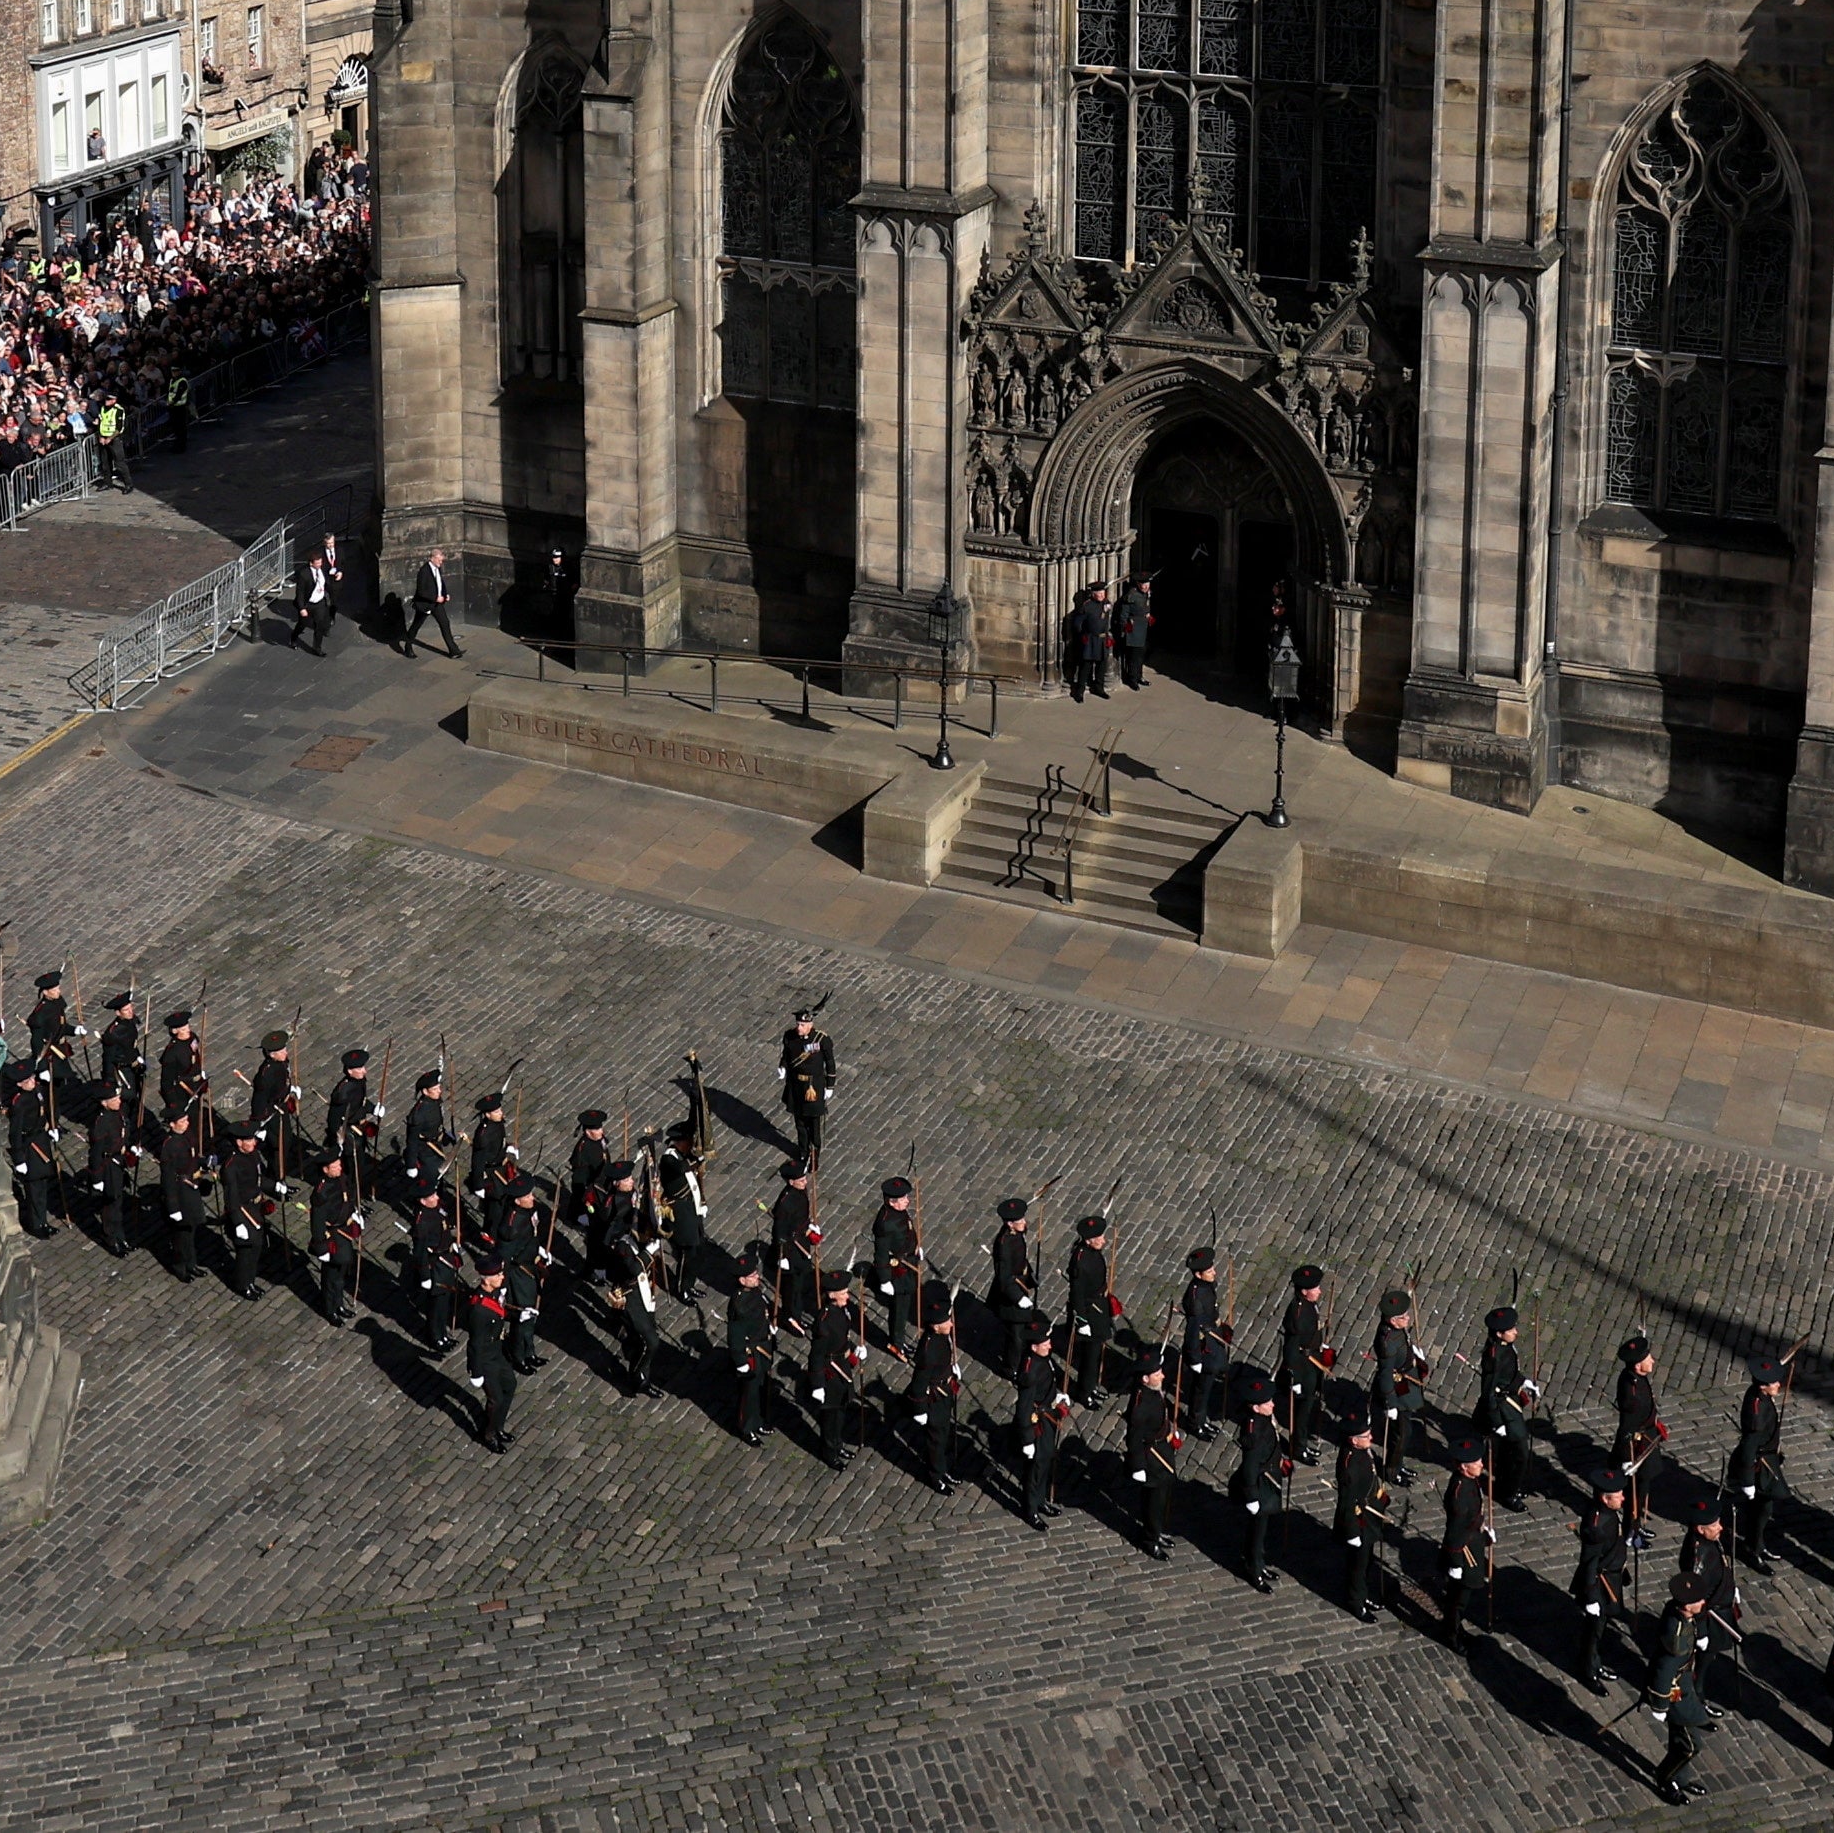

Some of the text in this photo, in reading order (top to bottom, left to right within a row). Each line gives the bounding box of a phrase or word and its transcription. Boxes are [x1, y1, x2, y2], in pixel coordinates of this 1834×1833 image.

[500, 713, 765, 775] ST GILES CATHEDRAL
